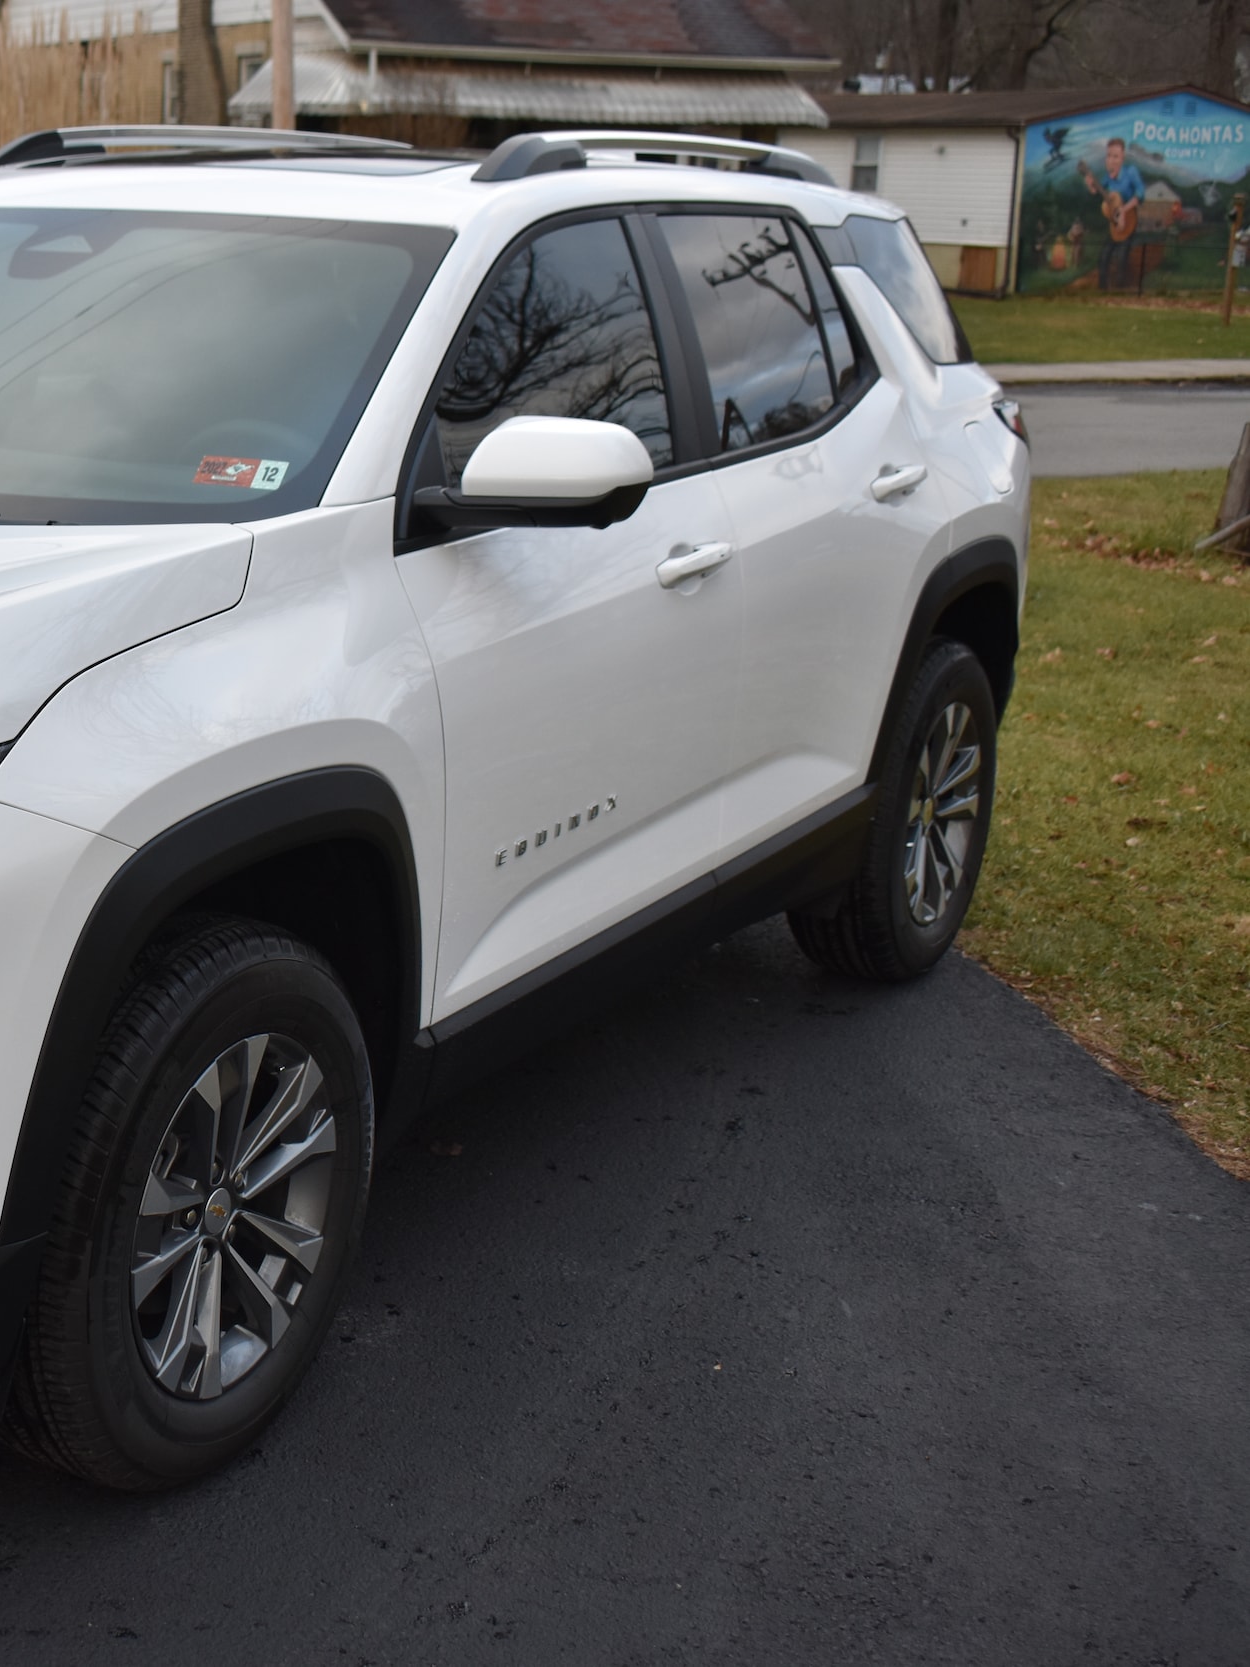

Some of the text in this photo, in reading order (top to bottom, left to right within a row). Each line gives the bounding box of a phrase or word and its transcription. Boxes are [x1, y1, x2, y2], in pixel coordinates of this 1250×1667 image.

[1133, 120, 1244, 144] POCAHONTAS
[1165, 147, 1206, 158] COUNTY
[261, 466, 279, 482] 12
[494, 794, 617, 867] EQUINOX
